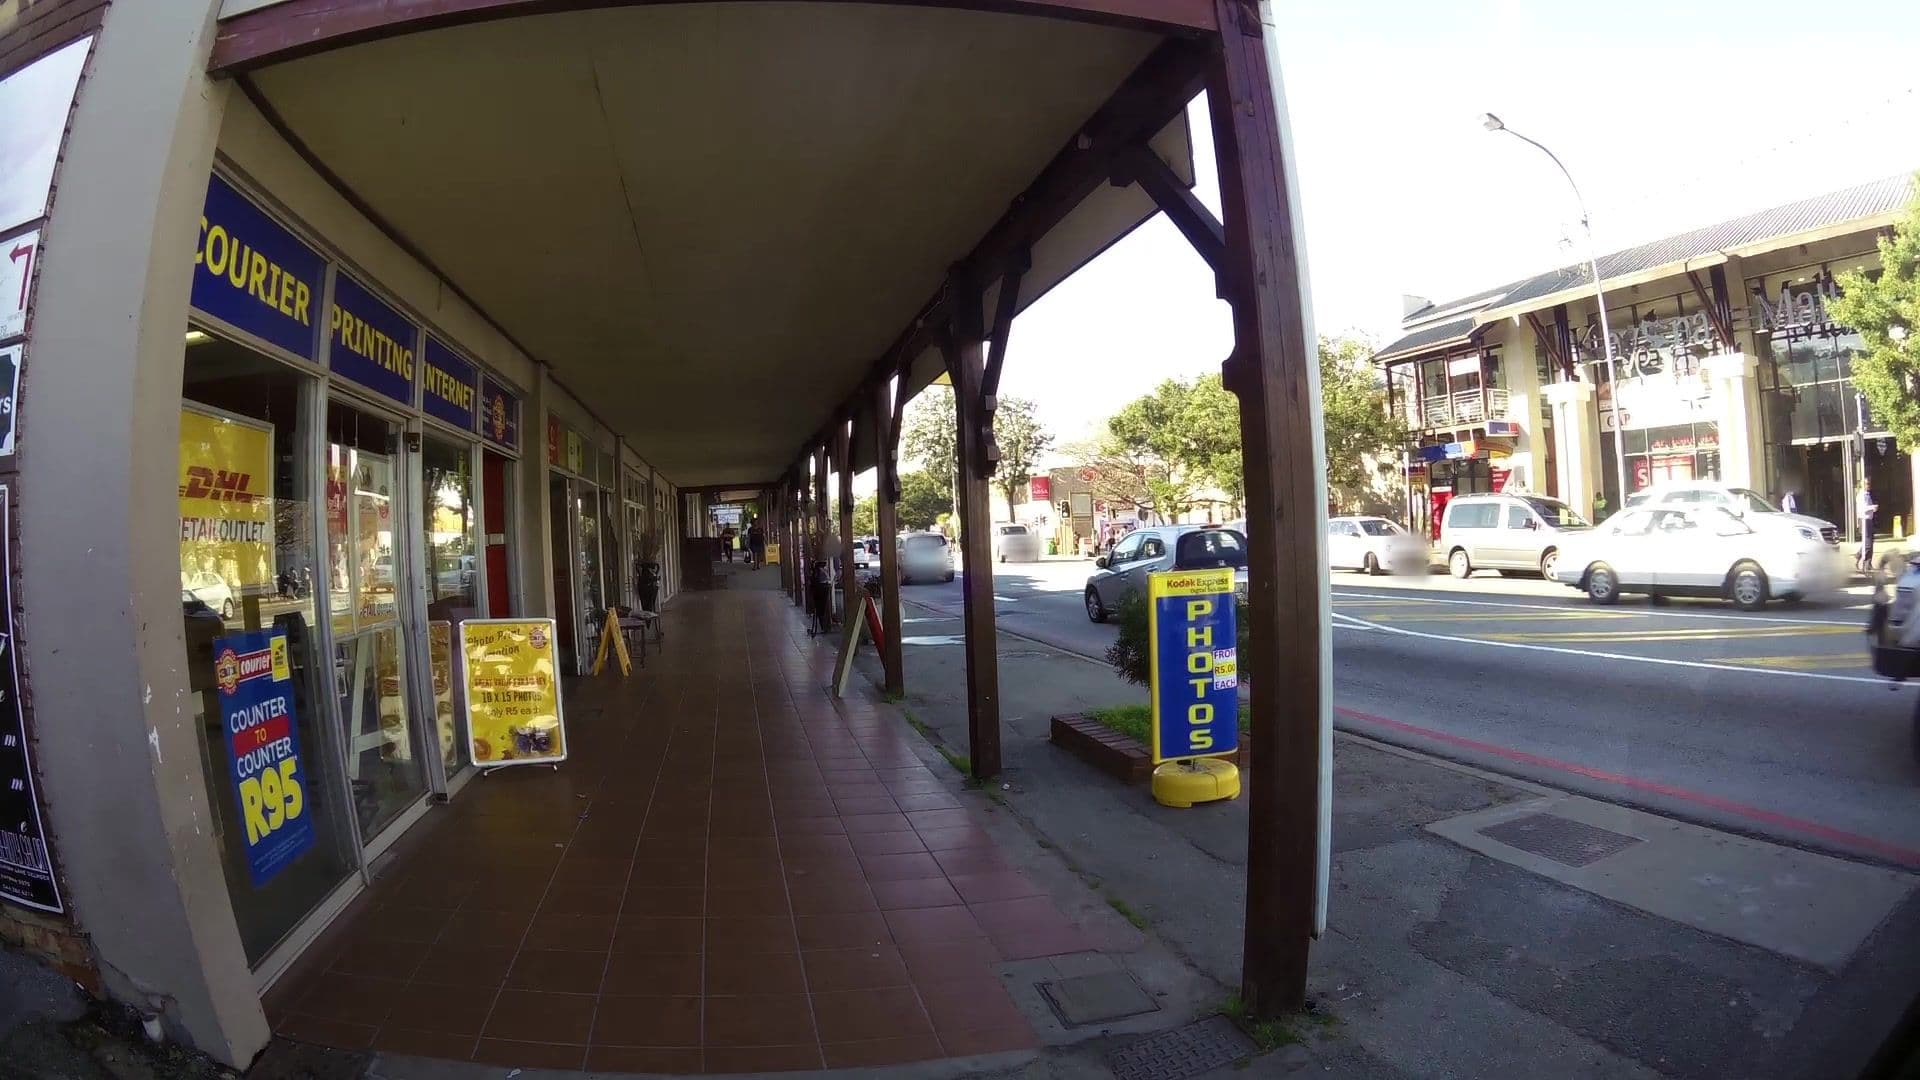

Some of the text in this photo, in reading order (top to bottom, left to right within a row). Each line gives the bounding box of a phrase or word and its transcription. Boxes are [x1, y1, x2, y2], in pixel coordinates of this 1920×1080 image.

[331, 304, 413, 381] PRINTING
[184, 465, 251, 503] DHL
[179, 516, 265, 542] ETAIL OUTLET
[1167, 577, 1228, 590] Kodak Express
[240, 654, 271, 676] courier
[1187, 600, 1214, 750] PHOTOS
[1214, 663, 1235, 675] R5.00
[1215, 679, 1236, 690] EACH
[482, 691, 492, 703] 10
[502, 691, 511, 702] 15
[230, 696, 287, 733] COUNTER
[505, 706, 518, 716] R5
[254, 727, 267, 744] TO
[237, 736, 293, 778] COUNTER
[239, 756, 303, 847] R95
